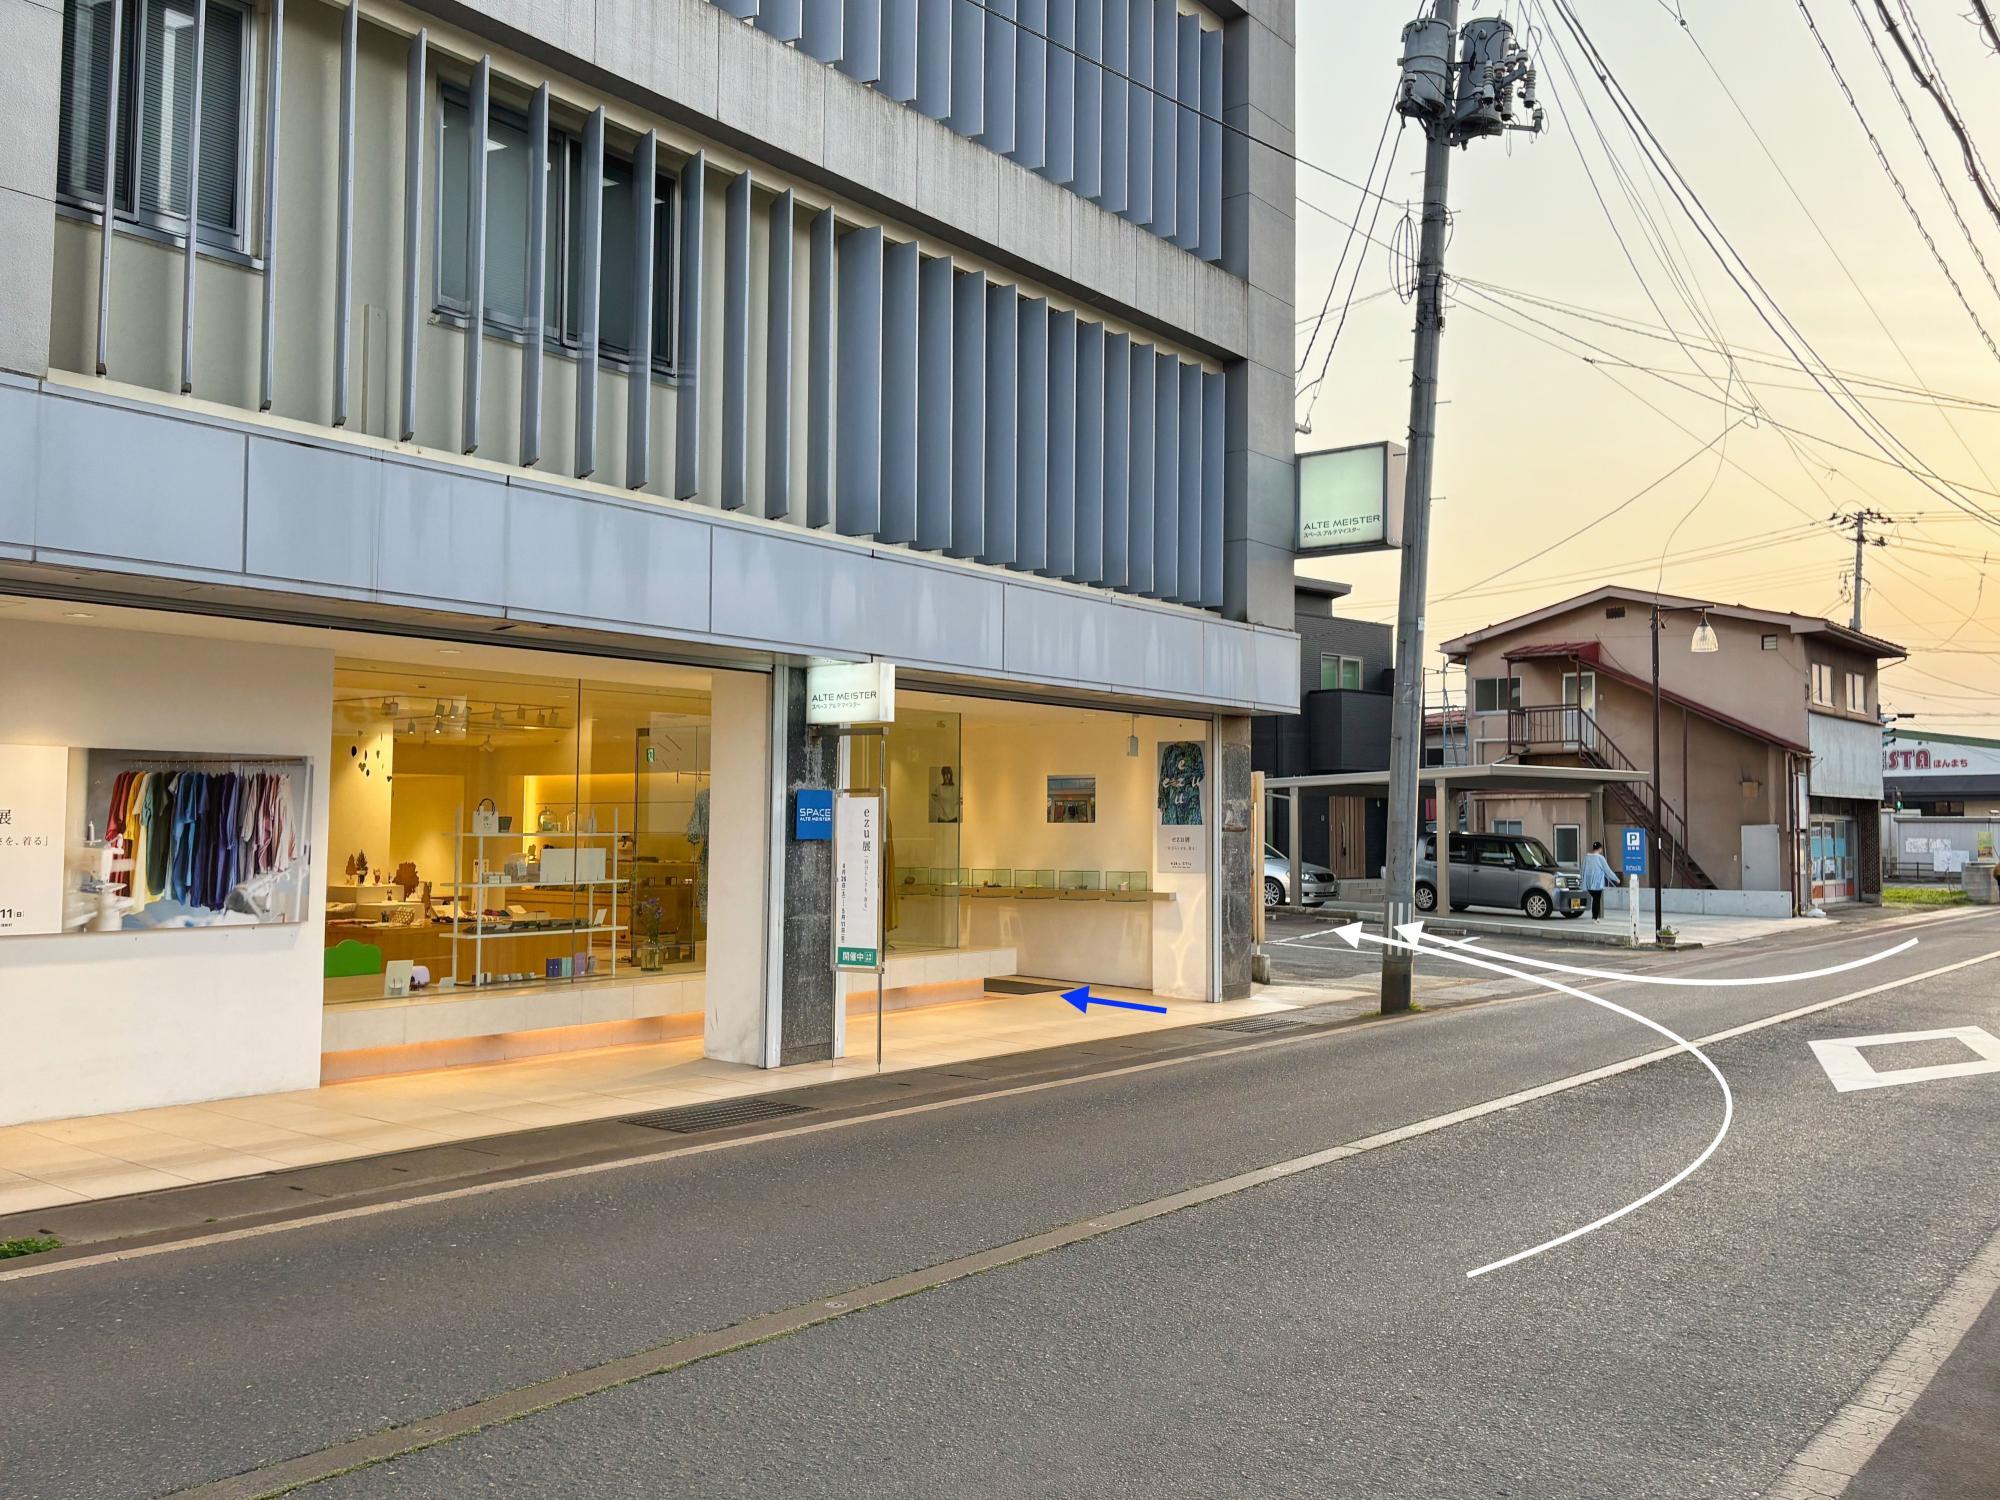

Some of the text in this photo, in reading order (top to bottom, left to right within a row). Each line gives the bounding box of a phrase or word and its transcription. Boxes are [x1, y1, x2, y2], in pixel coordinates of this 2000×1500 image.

[1304, 514, 1381, 531] ALTE MEISTER
[811, 690, 877, 703] ALTE MEISTER
[1882, 749, 1931, 770] STA
[1933, 758, 1969, 769] ほんまち
[799, 808, 832, 817] SPACE
[1629, 834, 1637, 844] P
